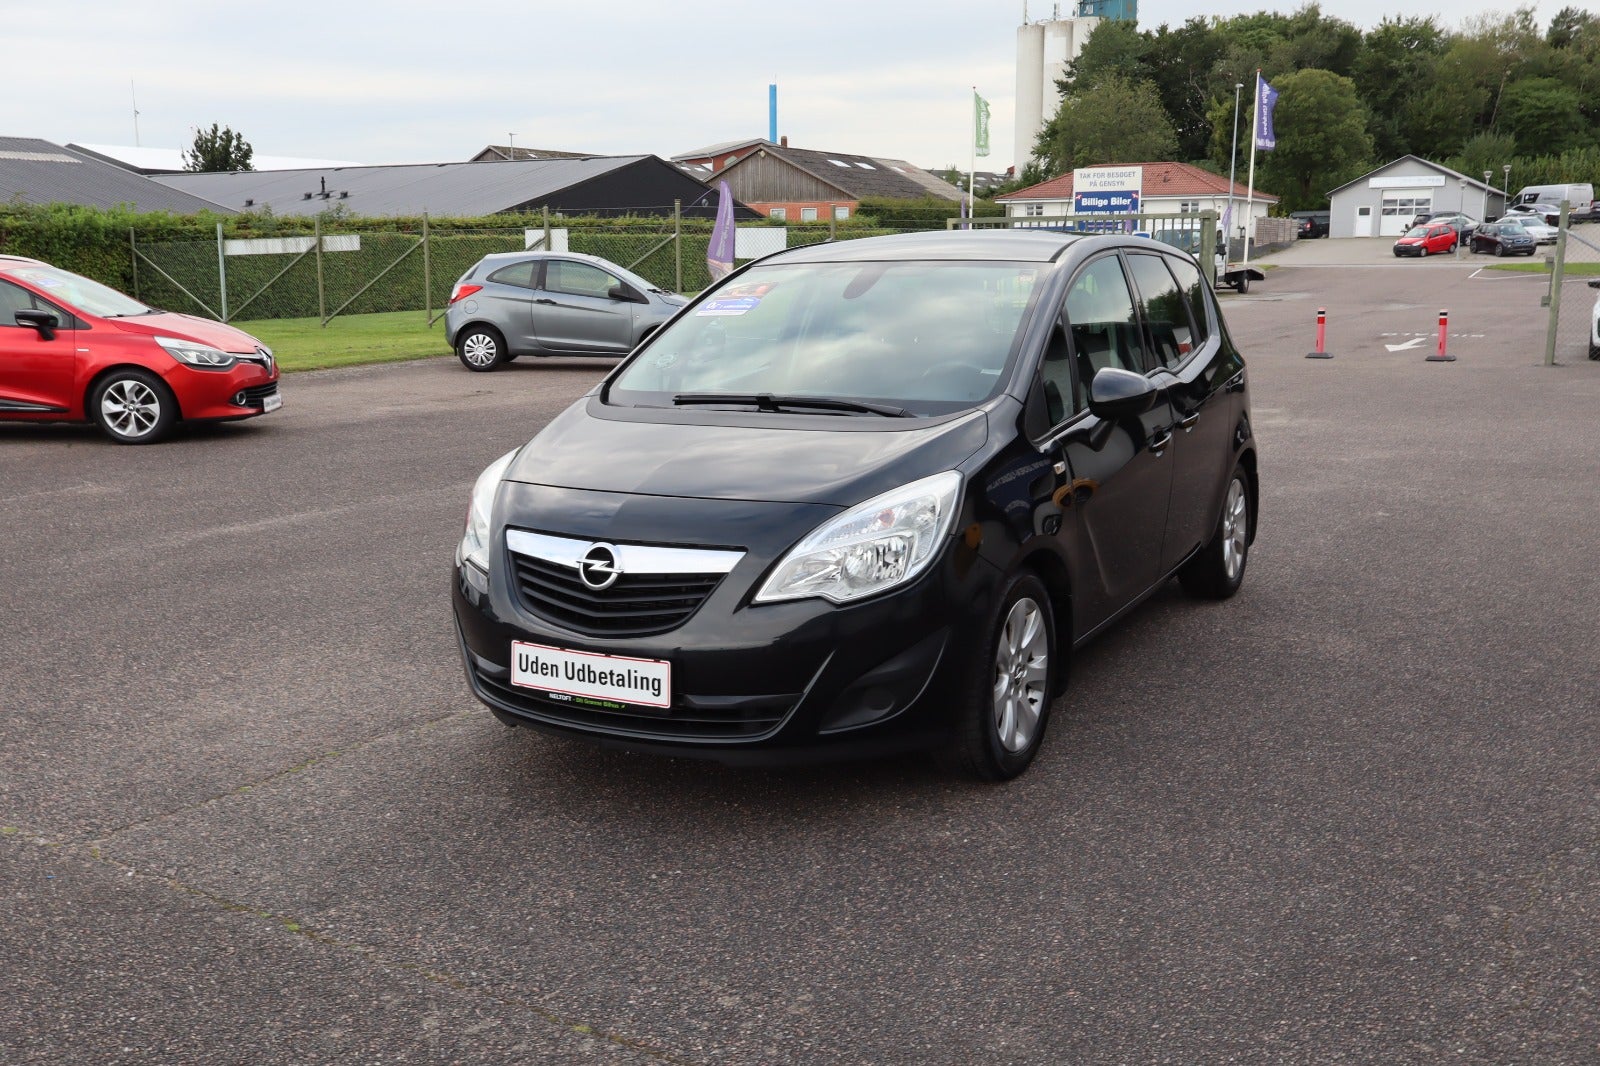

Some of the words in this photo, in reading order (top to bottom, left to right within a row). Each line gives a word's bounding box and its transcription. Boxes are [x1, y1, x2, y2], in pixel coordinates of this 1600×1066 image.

[1081, 197, 1109, 208] Billige
[1110, 196, 1132, 206] Biler
[519, 653, 559, 678] Uden
[564, 660, 662, 697] Udbetaling
